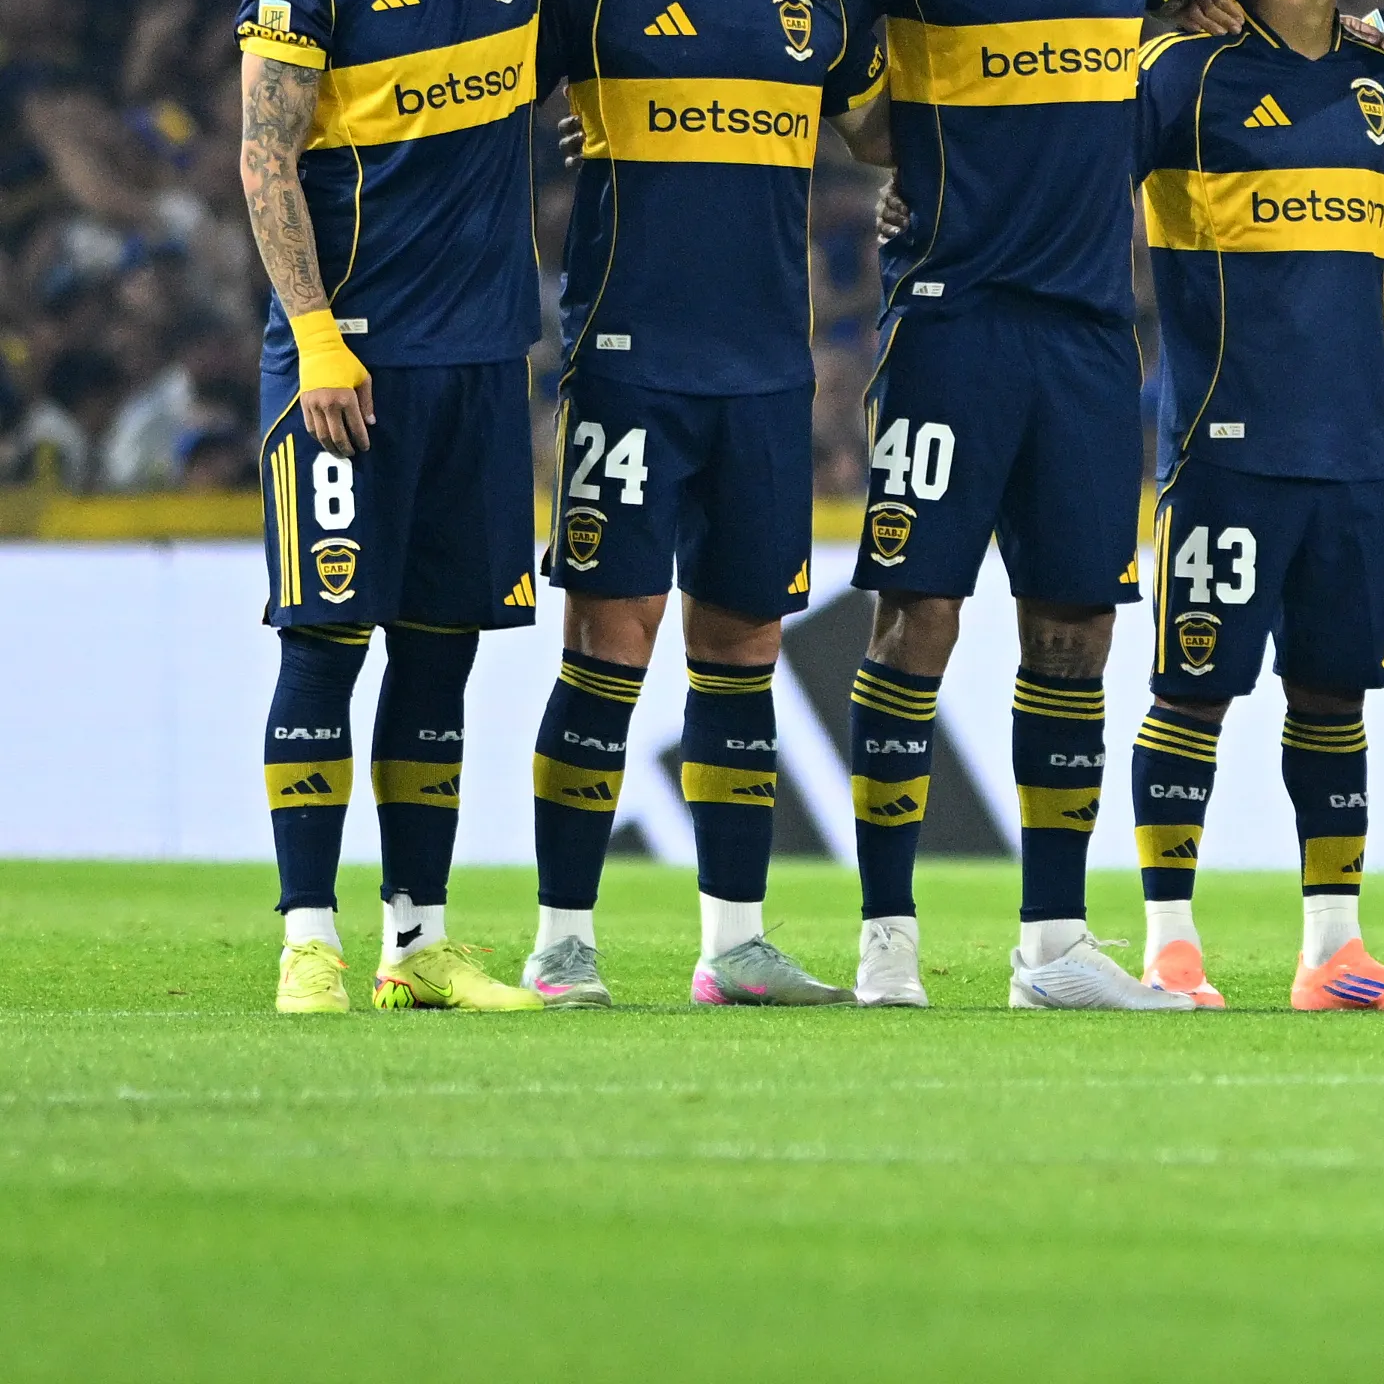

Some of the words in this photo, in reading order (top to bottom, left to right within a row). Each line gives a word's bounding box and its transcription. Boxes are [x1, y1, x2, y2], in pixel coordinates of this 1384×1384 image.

[786, 18, 807, 31] CABJ
[1363, 104, 1382, 116] CABJ
[649, 100, 809, 139] betsson
[568, 421, 648, 505] 24
[871, 418, 956, 501] 40
[312, 451, 356, 530] 8
[572, 532, 596, 542] CABJ
[877, 527, 905, 539] CABJ
[323, 564, 349, 574] CABJ
[1174, 526, 1257, 604] 43
[1185, 637, 1210, 646] CABJ
[274, 727, 342, 740] CABJ
